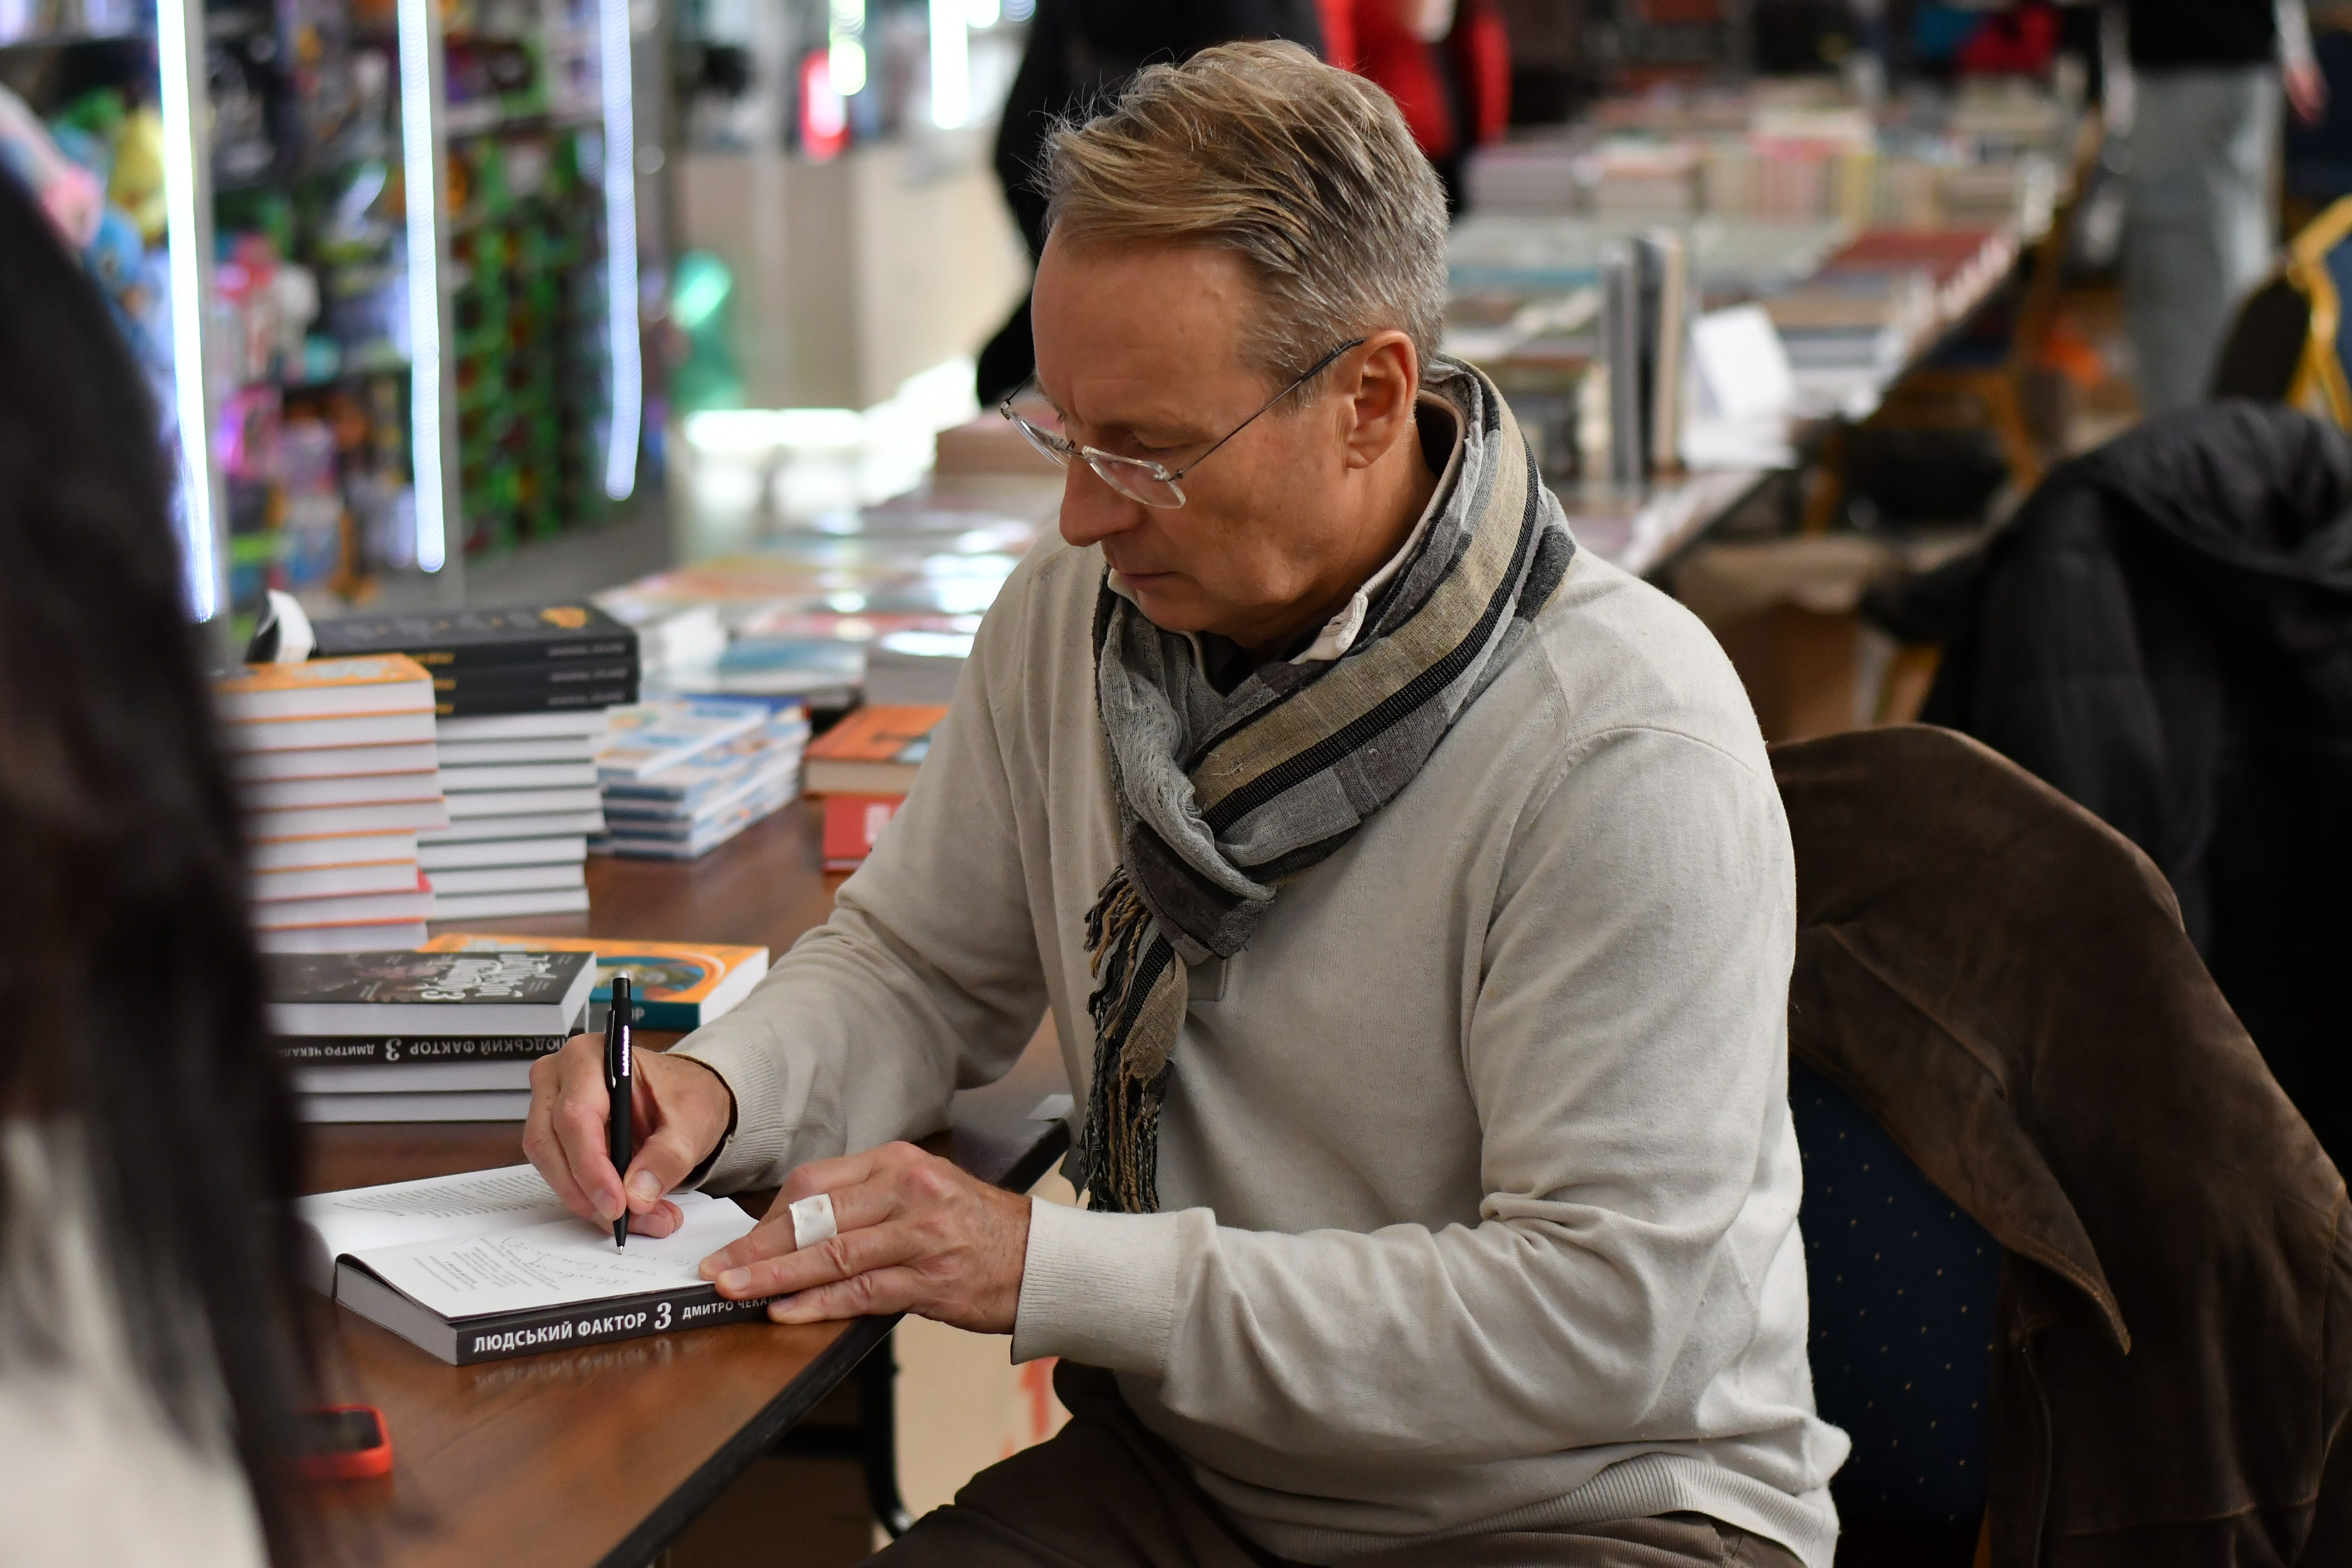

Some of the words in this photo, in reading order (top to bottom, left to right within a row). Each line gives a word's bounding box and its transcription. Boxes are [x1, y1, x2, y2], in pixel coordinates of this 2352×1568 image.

[324, 1043, 375, 1056] ДМИТРО
[385, 1038, 402, 1061] 3
[410, 1041, 475, 1055] ФАКТОР
[474, 1321, 573, 1353] ЛЮДСЬКИЙ
[578, 1312, 647, 1337] ФАКТОР
[654, 1302, 672, 1330] 3
[682, 1300, 734, 1320] ДМИТРО
